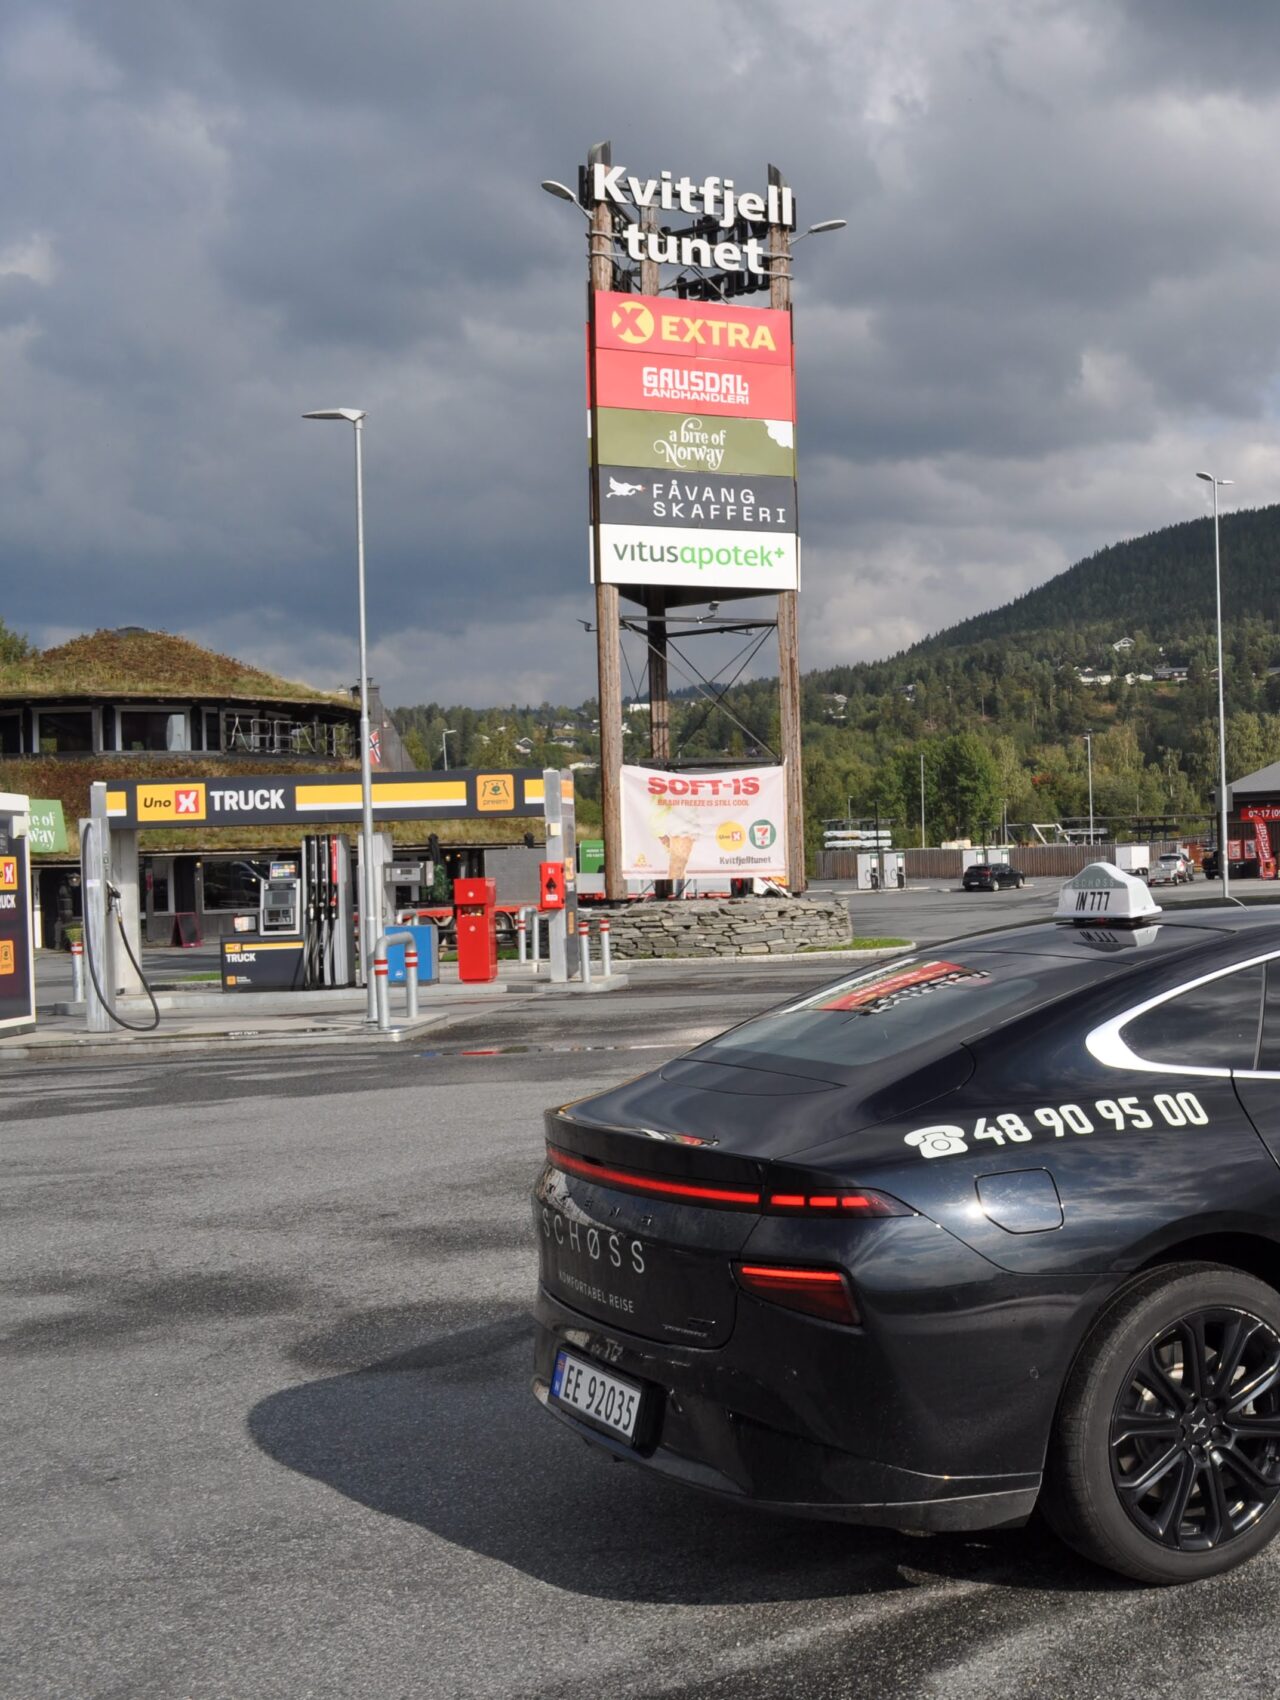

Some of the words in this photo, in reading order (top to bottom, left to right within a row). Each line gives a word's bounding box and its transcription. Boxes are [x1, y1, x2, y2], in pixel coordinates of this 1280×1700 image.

[594, 163, 793, 228] Kvitfjell
[623, 223, 764, 274] tunet
[661, 315, 776, 351] EXTRA
[642, 366, 749, 395] GAUSDAL
[643, 387, 749, 405] LANDHANDLERI
[669, 430, 678, 442] a
[680, 417, 709, 444] bite
[711, 430, 727, 444] of
[653, 440, 725, 471] Norway
[653, 480, 755, 504] FÅVANG
[653, 501, 786, 523] SKAFFERI
[647, 776, 760, 796] SOFT-IS
[143, 797, 172, 808] Uno
[210, 788, 285, 811] TRUCK
[41, 811, 56, 827] of
[28, 828, 56, 850] way
[719, 856, 771, 866] Kvitfjelltunet
[0, 894, 16, 909] UCK
[1075, 891, 1088, 911] IN
[1090, 891, 1110, 911] 777
[225, 953, 256, 963] TRUCK
[973, 1113, 1032, 1145] 48
[1034, 1104, 1094, 1137] 90
[1095, 1096, 1153, 1130] 95
[1153, 1092, 1209, 1126] 00
[543, 1208, 645, 1273] SCHØSS
[558, 1271, 607, 1304] KOMFORTABEL
[609, 1295, 634, 1314] REISE
[563, 1364, 583, 1401] EE
[585, 1376, 635, 1431] 92035
